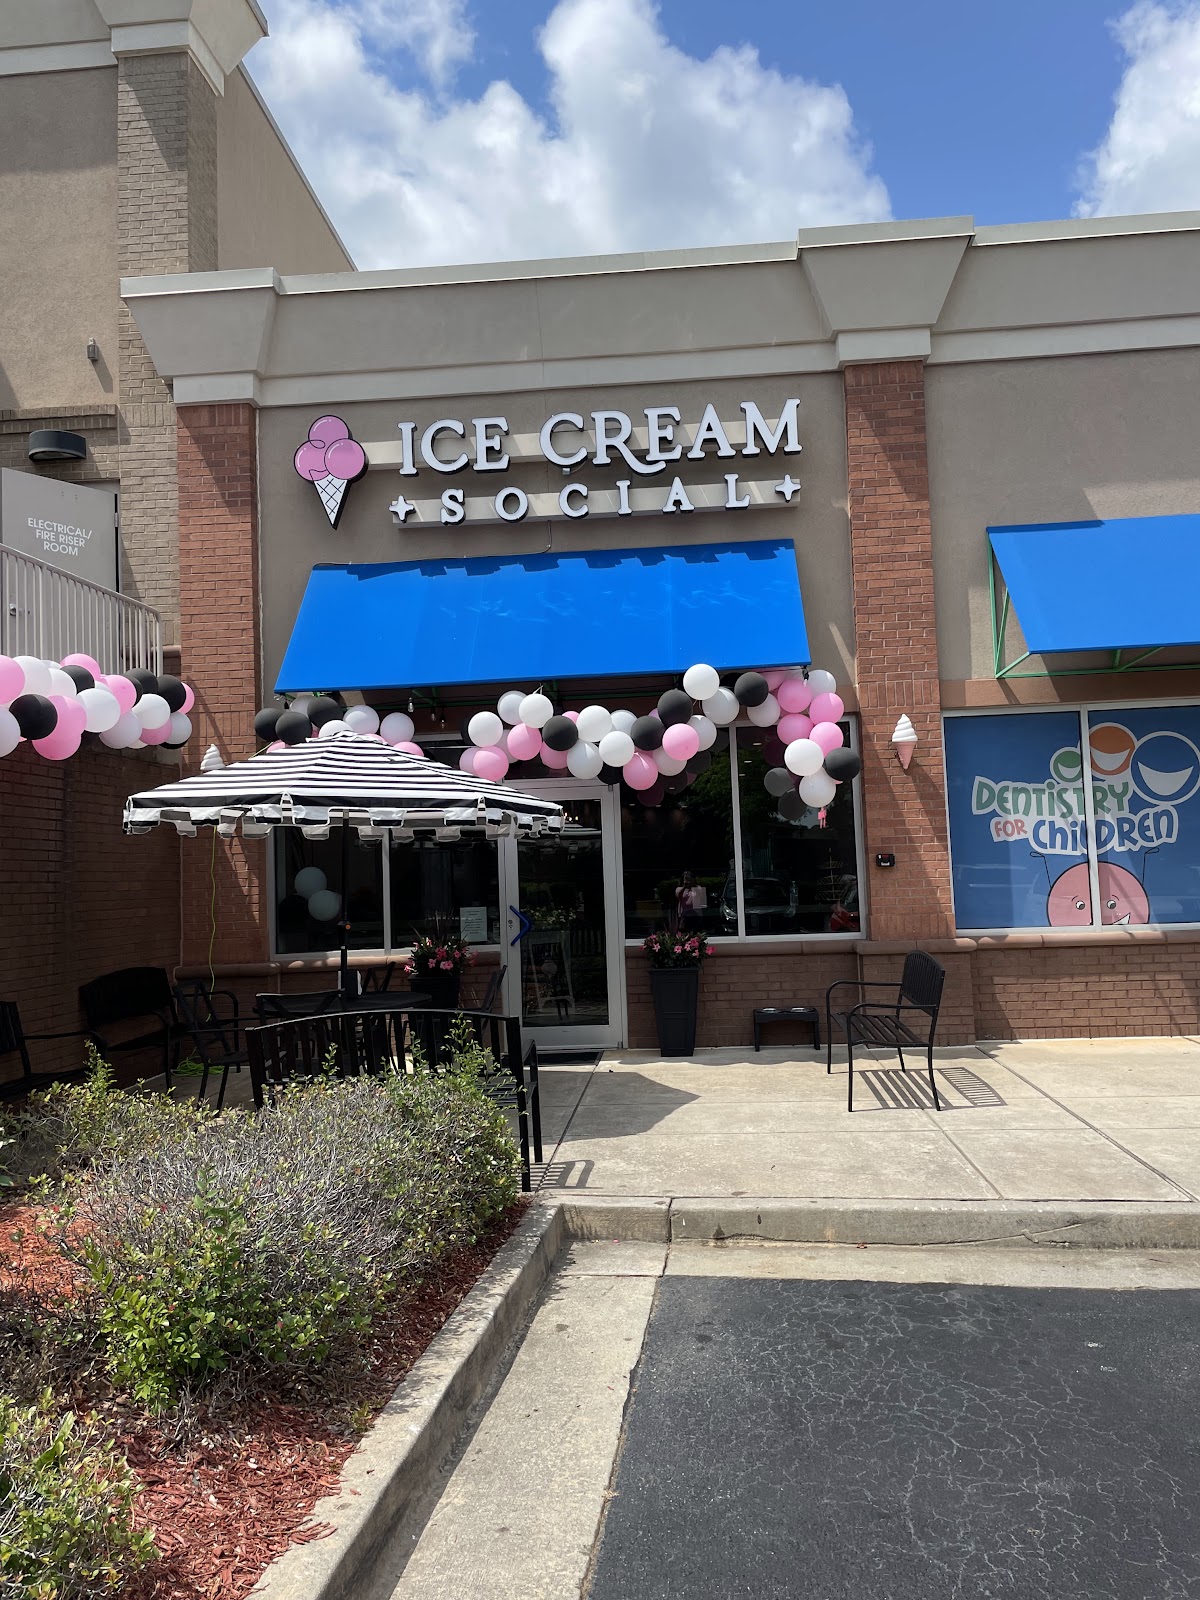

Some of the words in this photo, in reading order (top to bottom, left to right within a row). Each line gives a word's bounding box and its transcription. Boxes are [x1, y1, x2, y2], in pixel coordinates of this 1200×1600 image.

[397, 416, 511, 474] ICE
[539, 397, 803, 474] CREAM
[440, 473, 751, 526] SOCIAL
[28, 517, 92, 539] ELECTRICAL/
[36, 529, 56, 541] FIRE
[59, 534, 85, 547] RISER
[43, 541, 78, 556] ROOM
[994, 818, 1028, 838] FOR
